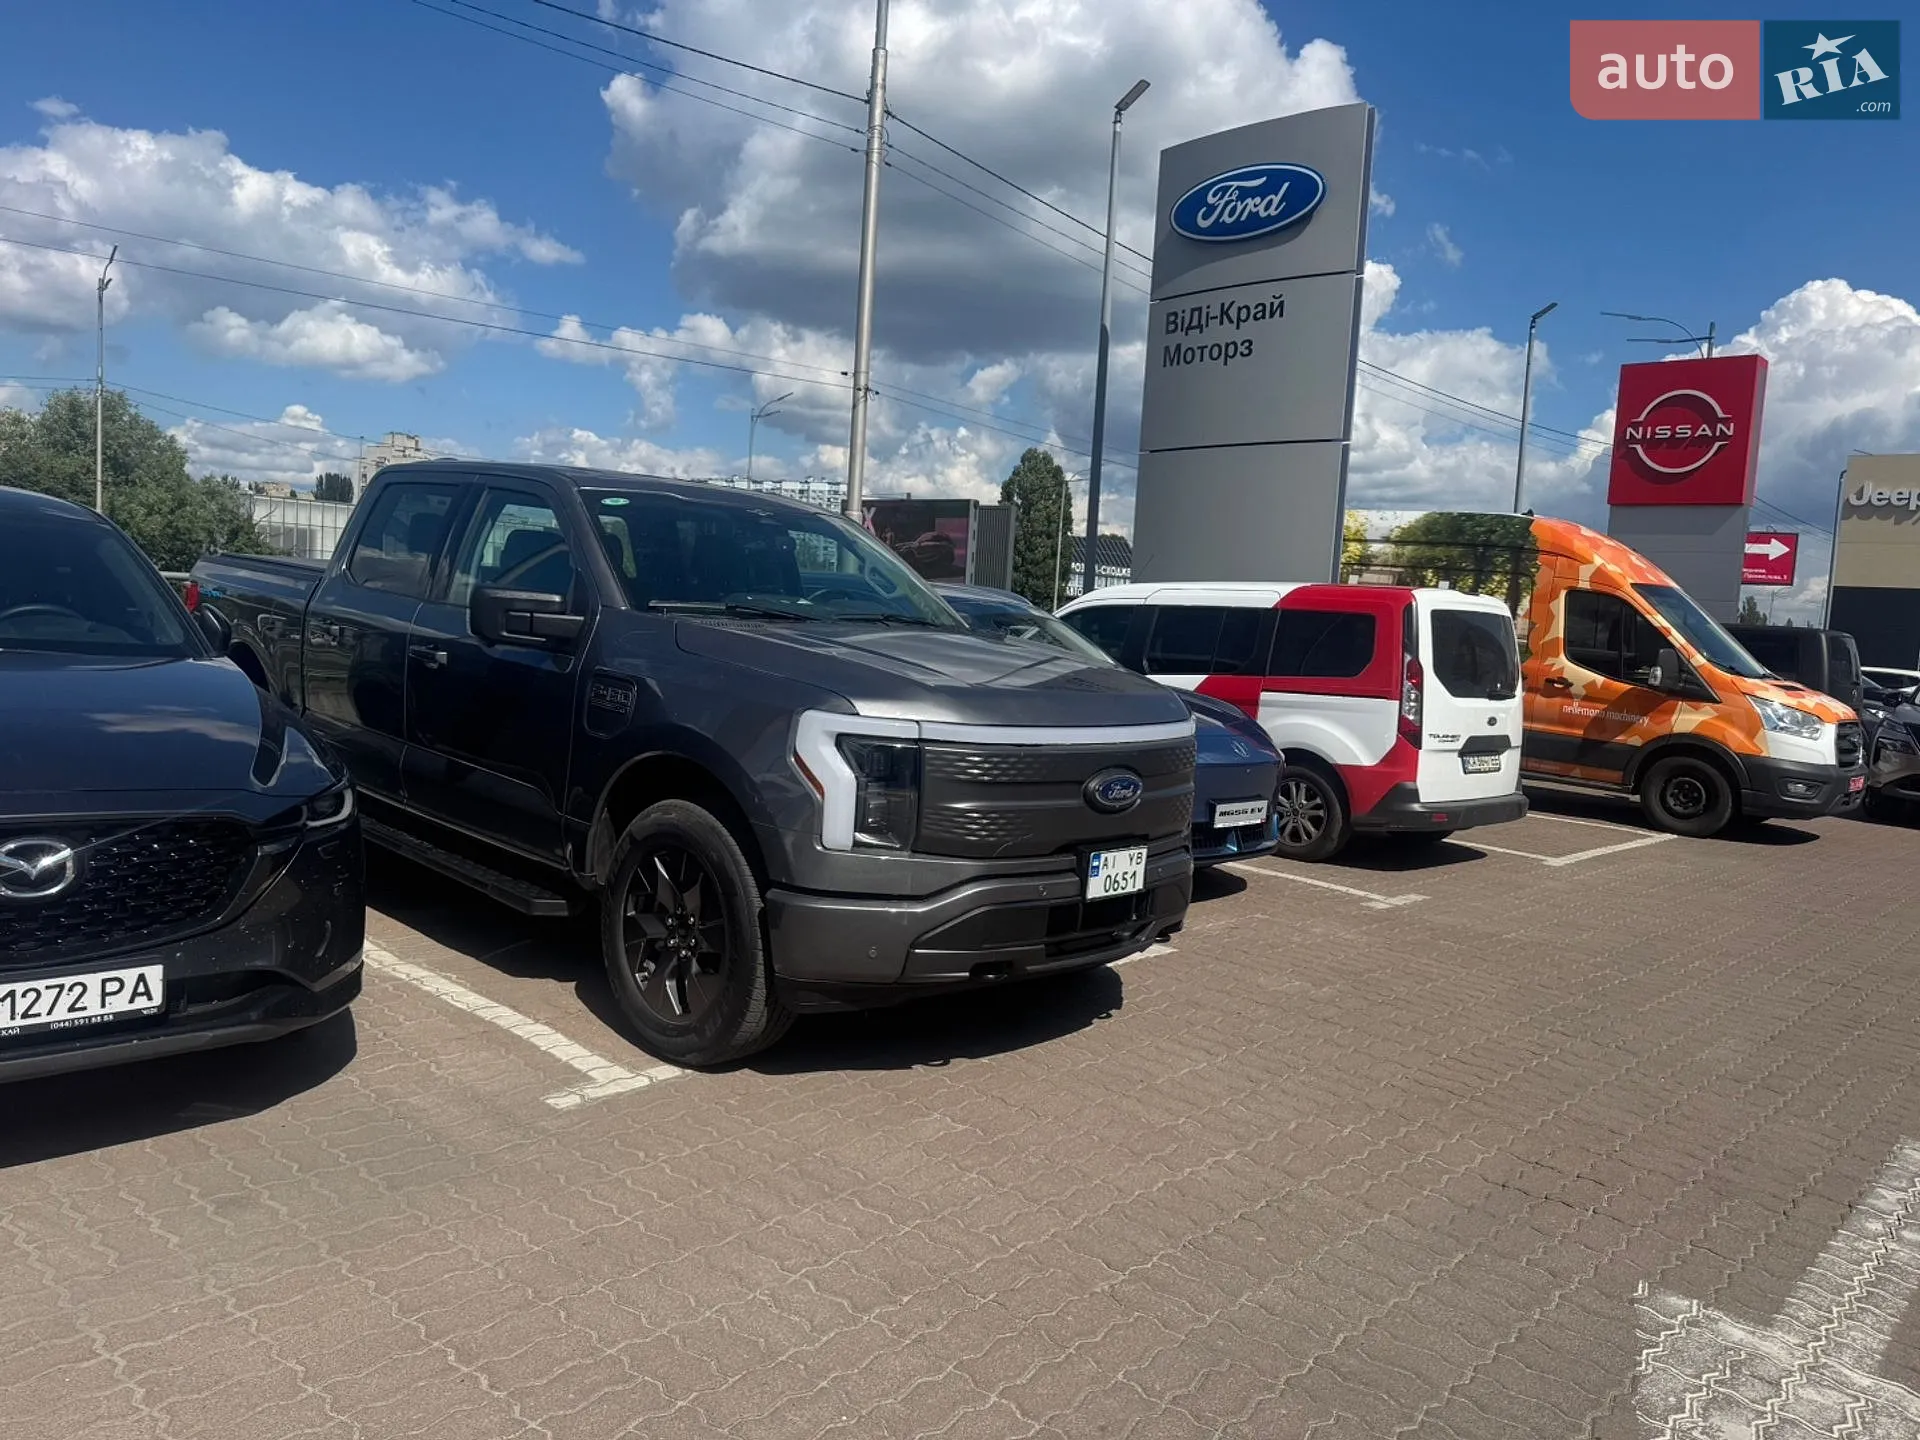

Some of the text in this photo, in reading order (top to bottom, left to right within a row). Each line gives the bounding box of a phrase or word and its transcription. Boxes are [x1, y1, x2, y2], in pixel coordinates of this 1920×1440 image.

[1196, 176, 1291, 228] Ford
[1165, 294, 1285, 336] ВіДі-Край
[1162, 338, 1254, 368] Моторз
[1626, 422, 1735, 441] NISSAN
[1108, 783, 1134, 799] Ford
[1104, 870, 1137, 893] 0651
[100, 973, 154, 1009] PA
